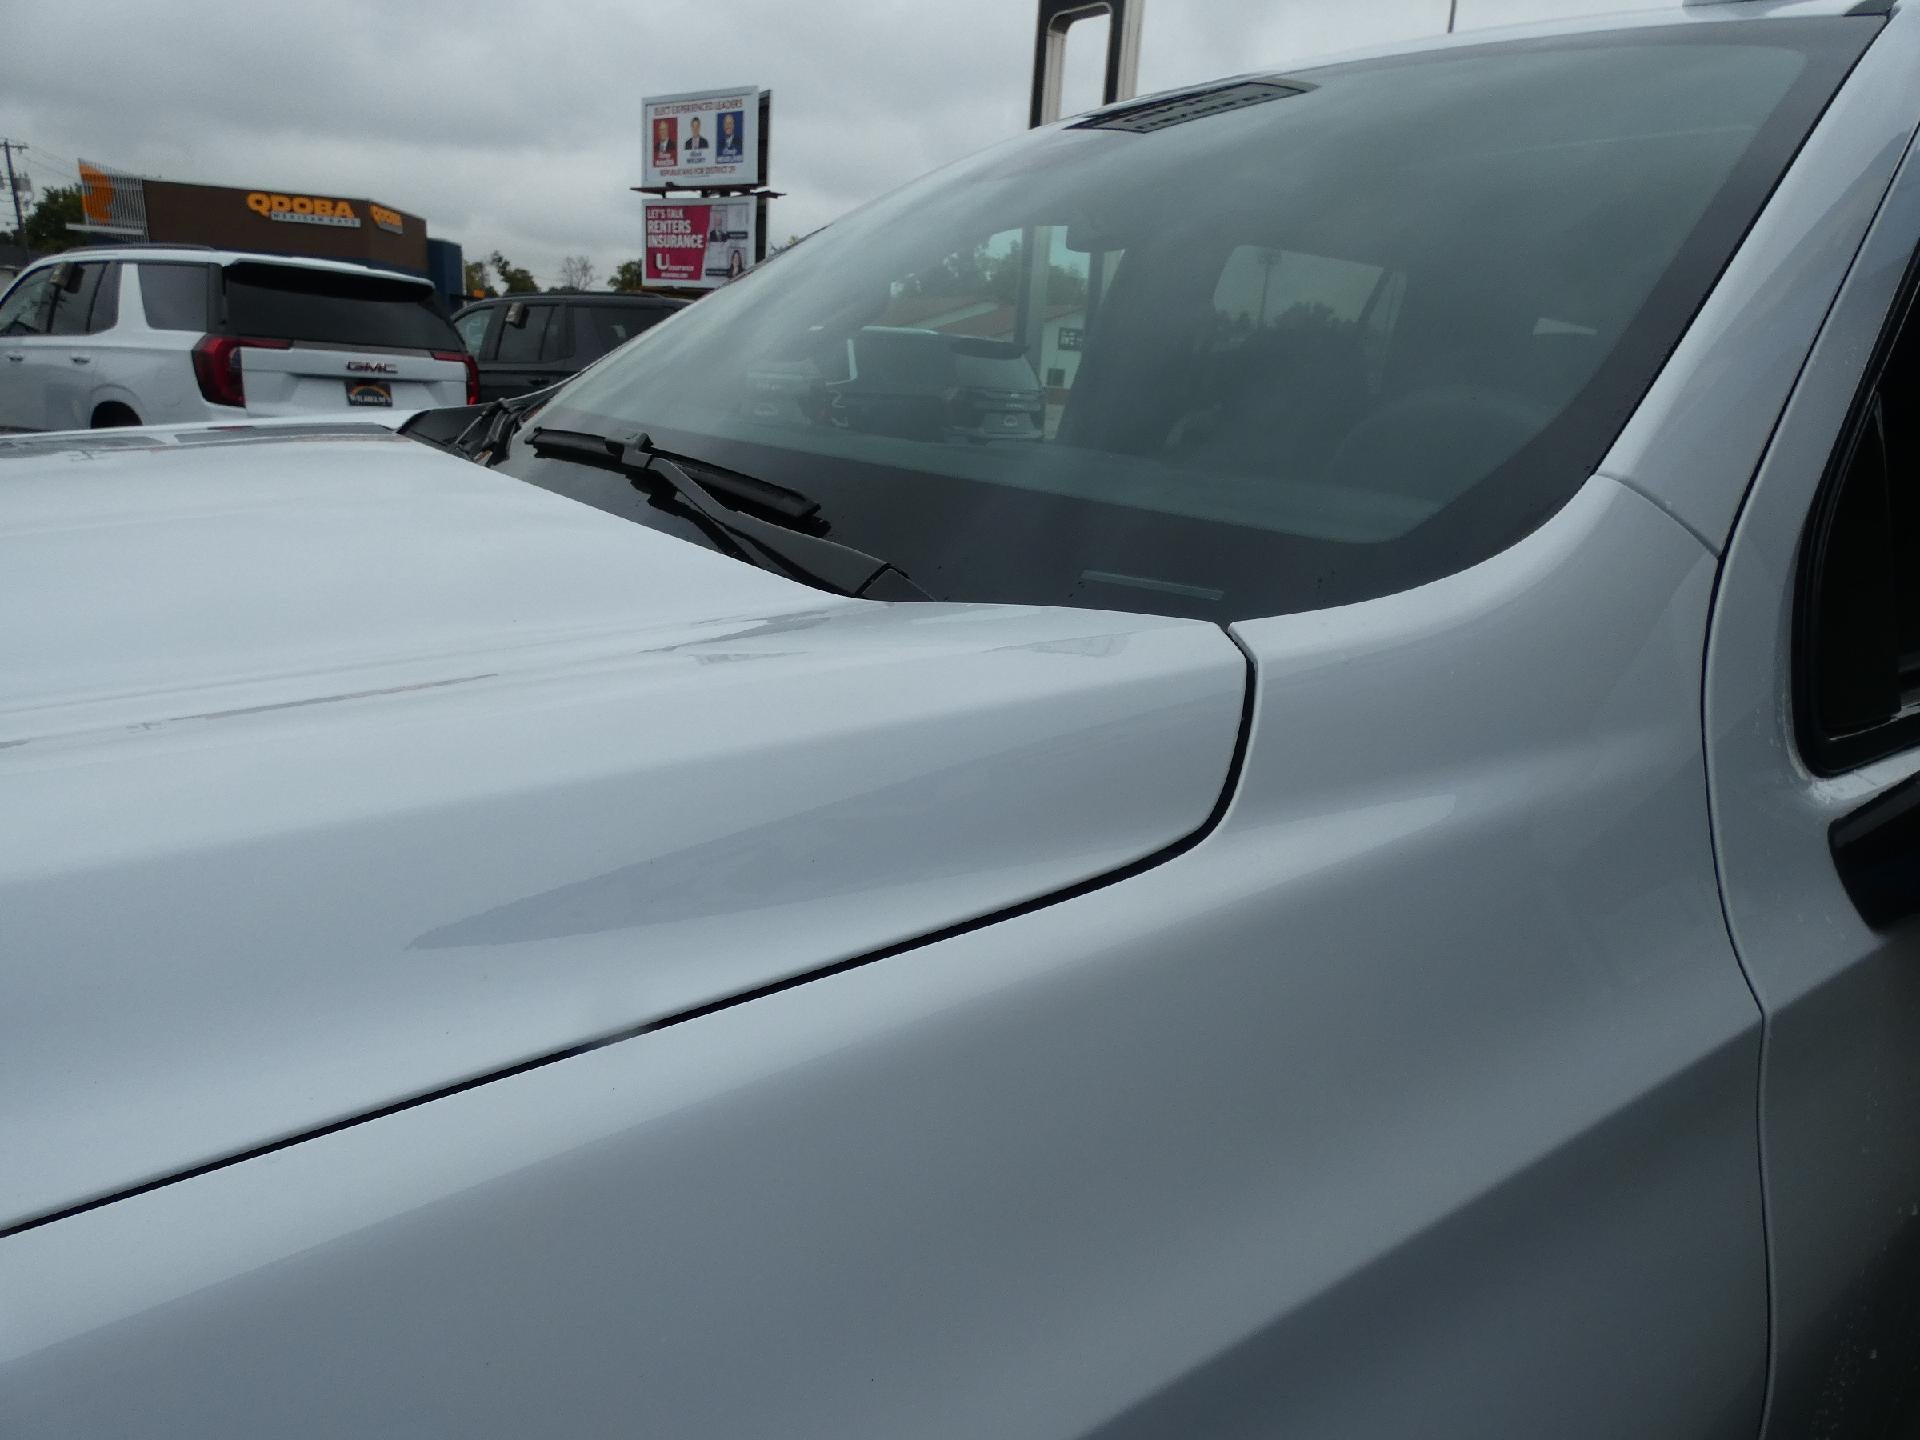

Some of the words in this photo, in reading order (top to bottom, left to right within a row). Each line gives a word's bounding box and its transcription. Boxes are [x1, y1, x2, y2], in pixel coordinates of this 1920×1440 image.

[247, 192, 356, 219] QDOBA
[647, 219, 691, 234] RENTERS
[647, 234, 704, 249] INSURANCE
[346, 361, 399, 374] GMC
